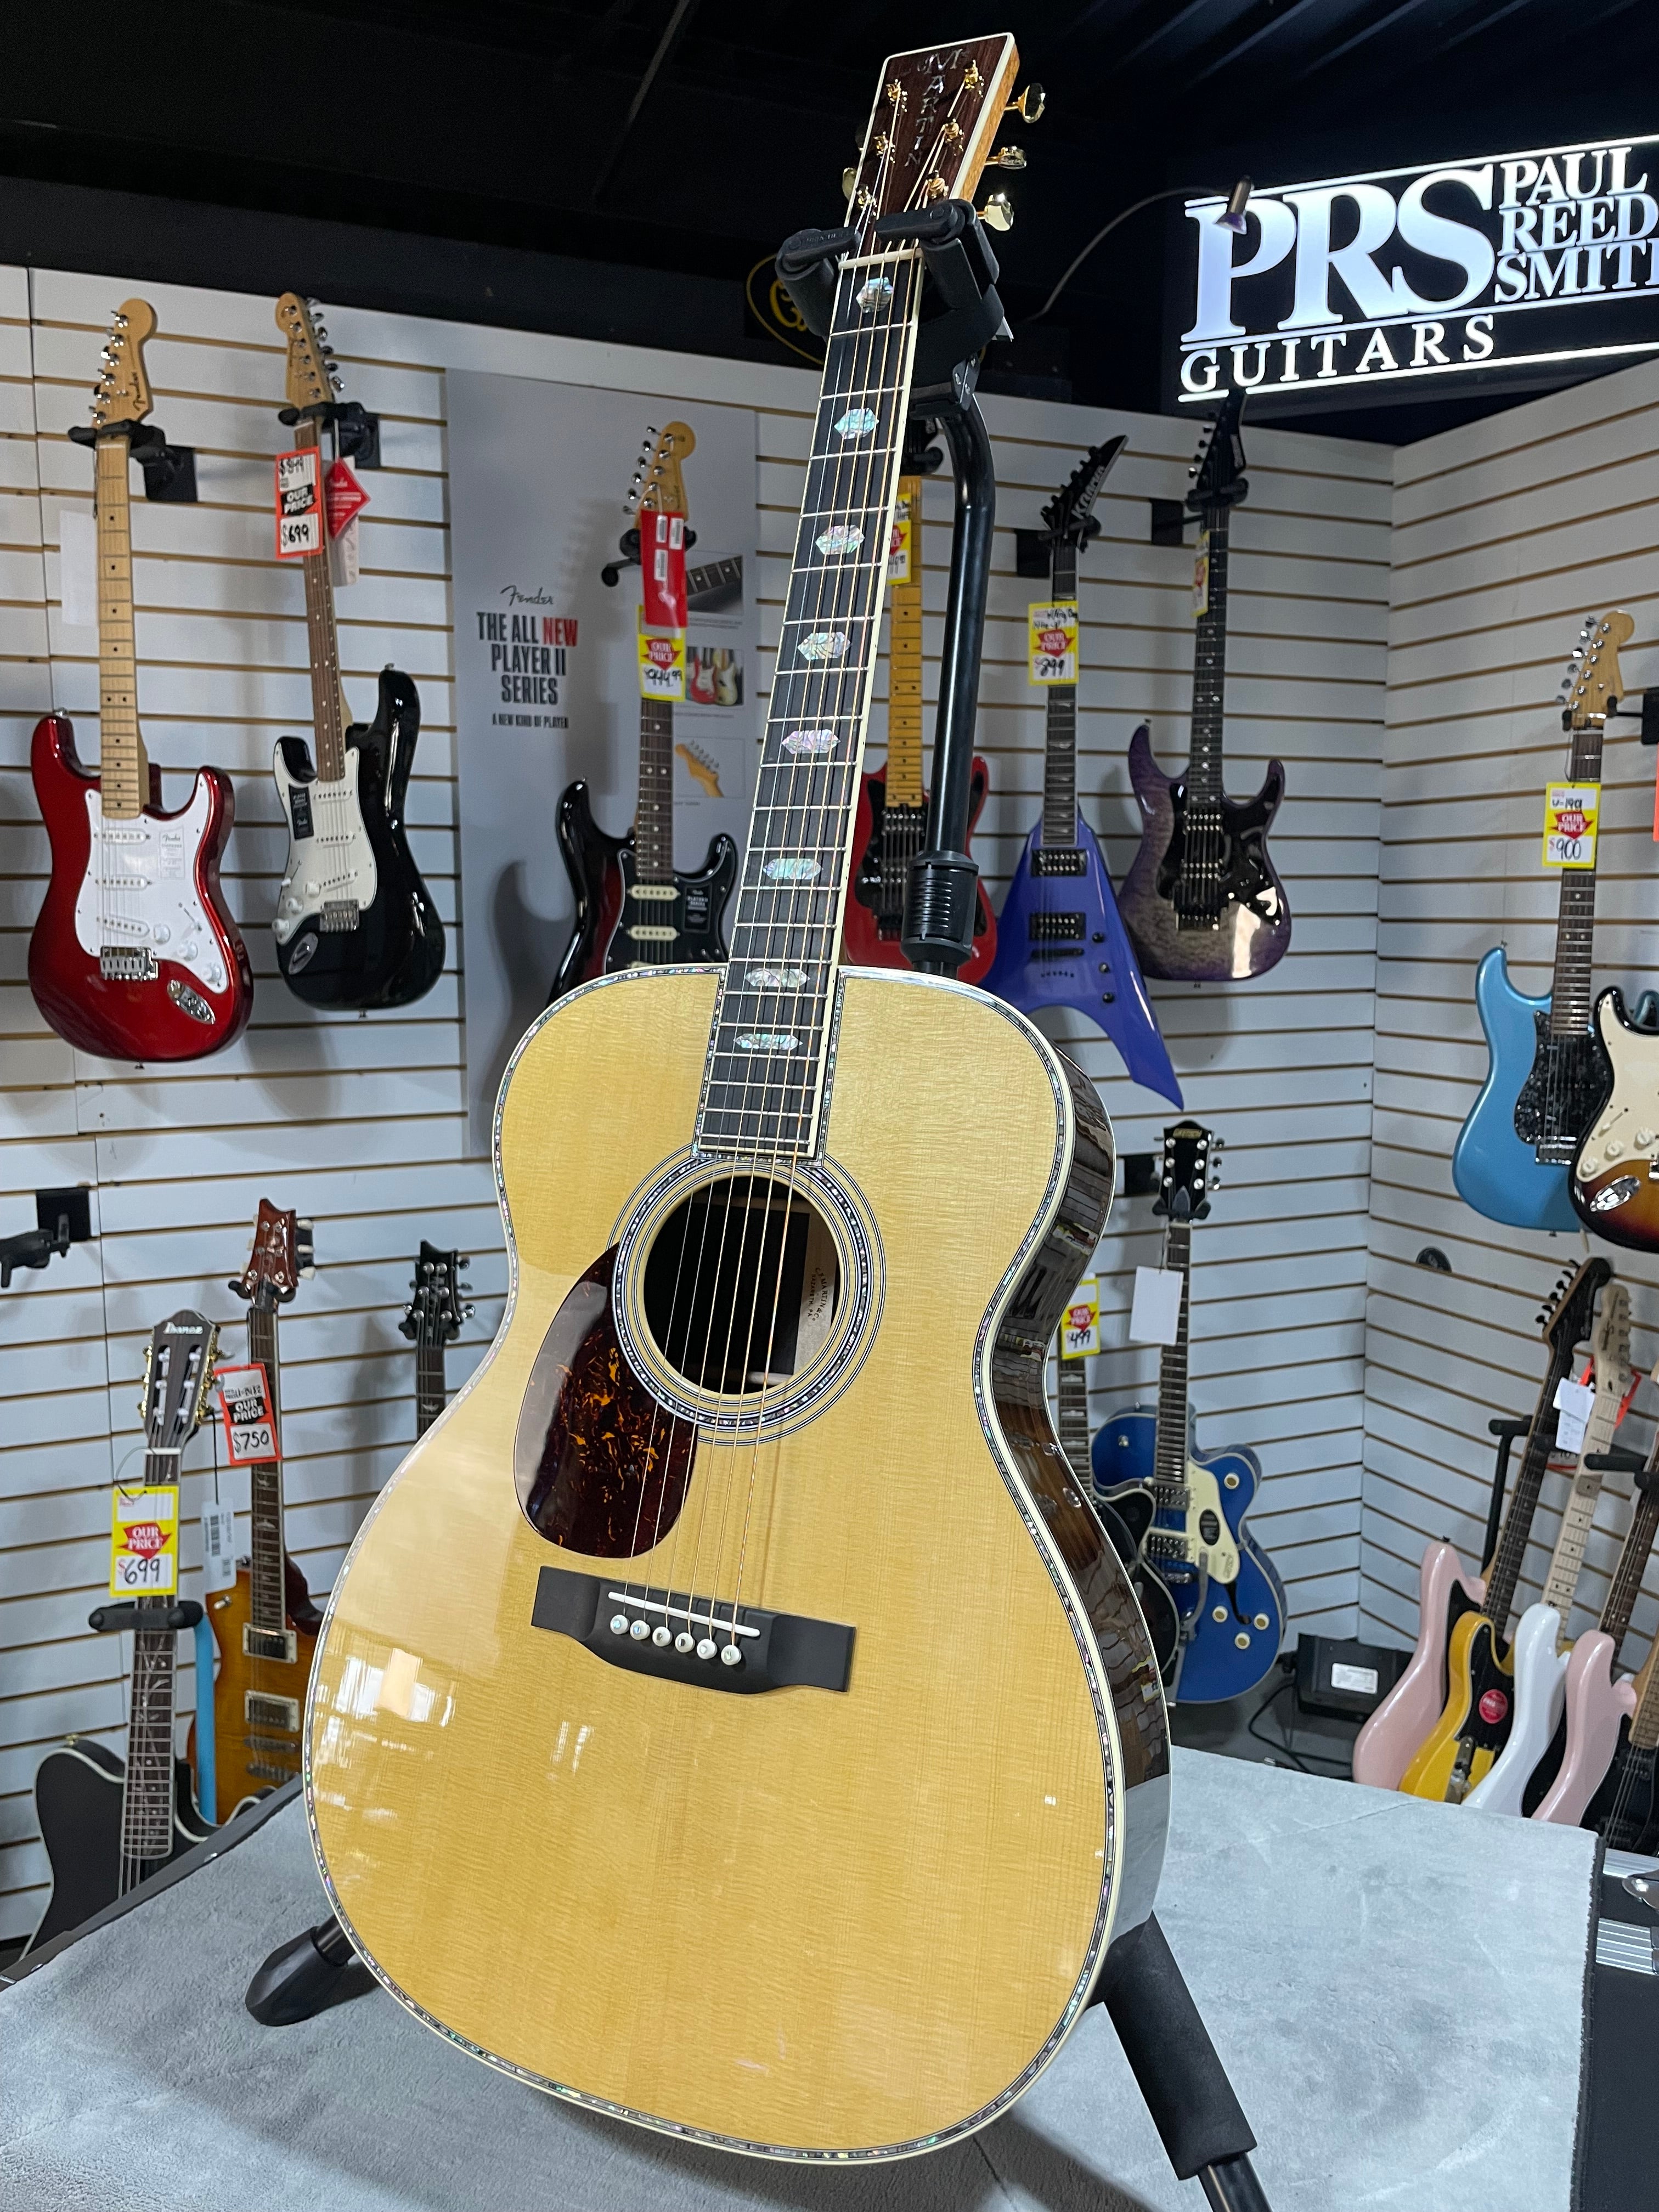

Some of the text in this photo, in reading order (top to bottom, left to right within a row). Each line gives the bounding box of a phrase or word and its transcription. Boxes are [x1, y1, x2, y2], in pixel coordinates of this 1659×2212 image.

[1499, 147, 1647, 209] PAUL
[1498, 193, 1659, 256] REED
[1182, 164, 1495, 343] PRS
[1181, 313, 1495, 393] GUITARS
[284, 495, 314, 515] PRICE
[285, 487, 309, 503] OUR
[281, 524, 309, 547] $699
[500, 585, 554, 606] Fender
[476, 612, 578, 648] THE ALL NEW
[491, 644, 567, 676] PLAYER II
[501, 674, 558, 705] SERIES
[492, 713, 498, 725] A
[499, 714, 513, 726] NEW
[544, 715, 568, 729] PLAYER
[1558, 821, 1586, 832] PRICE
[1561, 814, 1583, 823] OUR
[233, 1407, 264, 1424] PRICE
[235, 1398, 258, 1412] OUR
[233, 1430, 269, 1454] $750
[132, 1526, 159, 1538] OUR
[127, 1537, 163, 1550] PRICE
